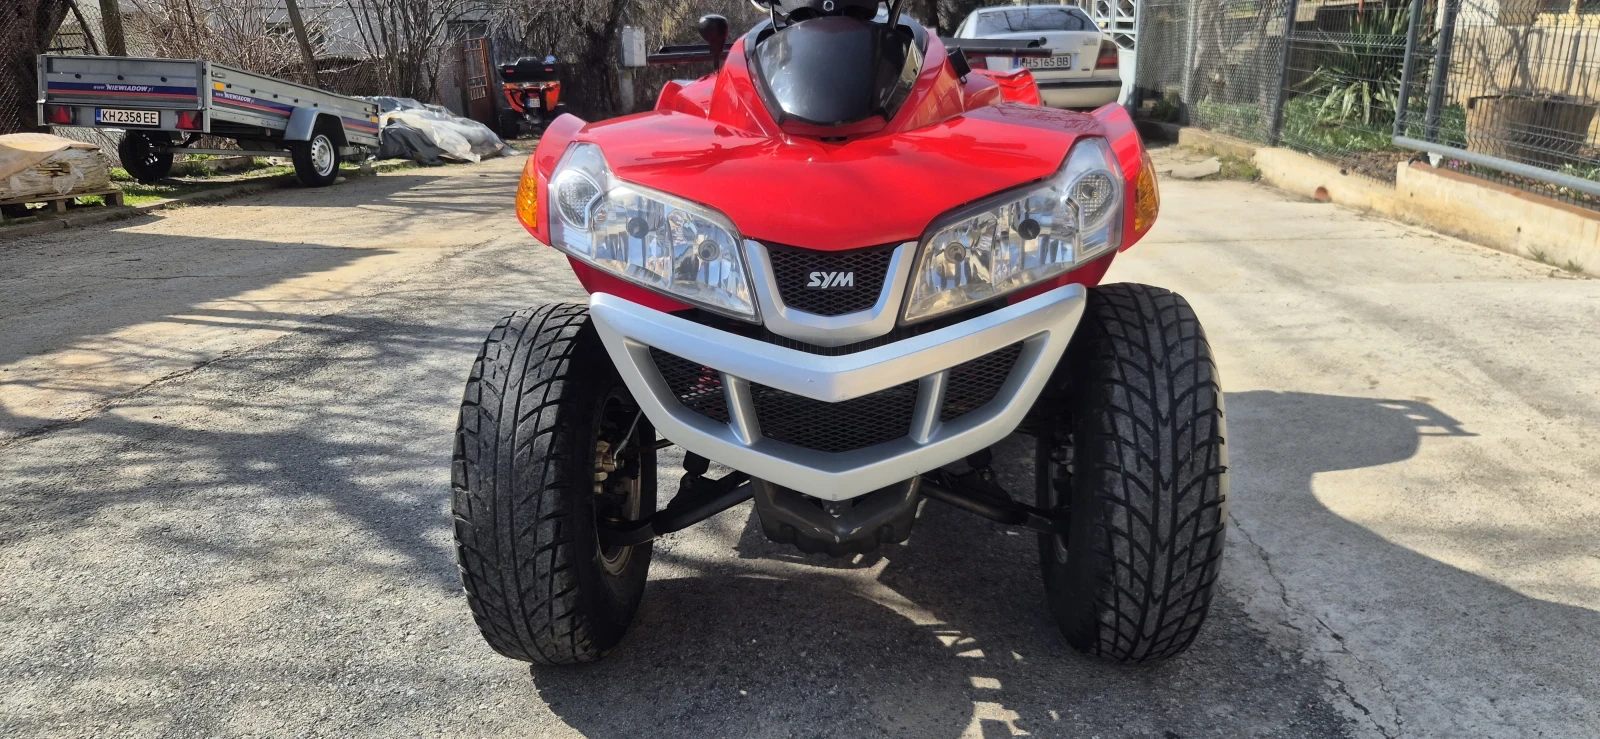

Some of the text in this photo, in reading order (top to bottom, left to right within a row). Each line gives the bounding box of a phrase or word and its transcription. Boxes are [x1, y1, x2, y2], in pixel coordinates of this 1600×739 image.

[1057, 57, 1069, 66] BB
[102, 110, 157, 124] KH 2358 EE
[807, 271, 854, 289] SYM
